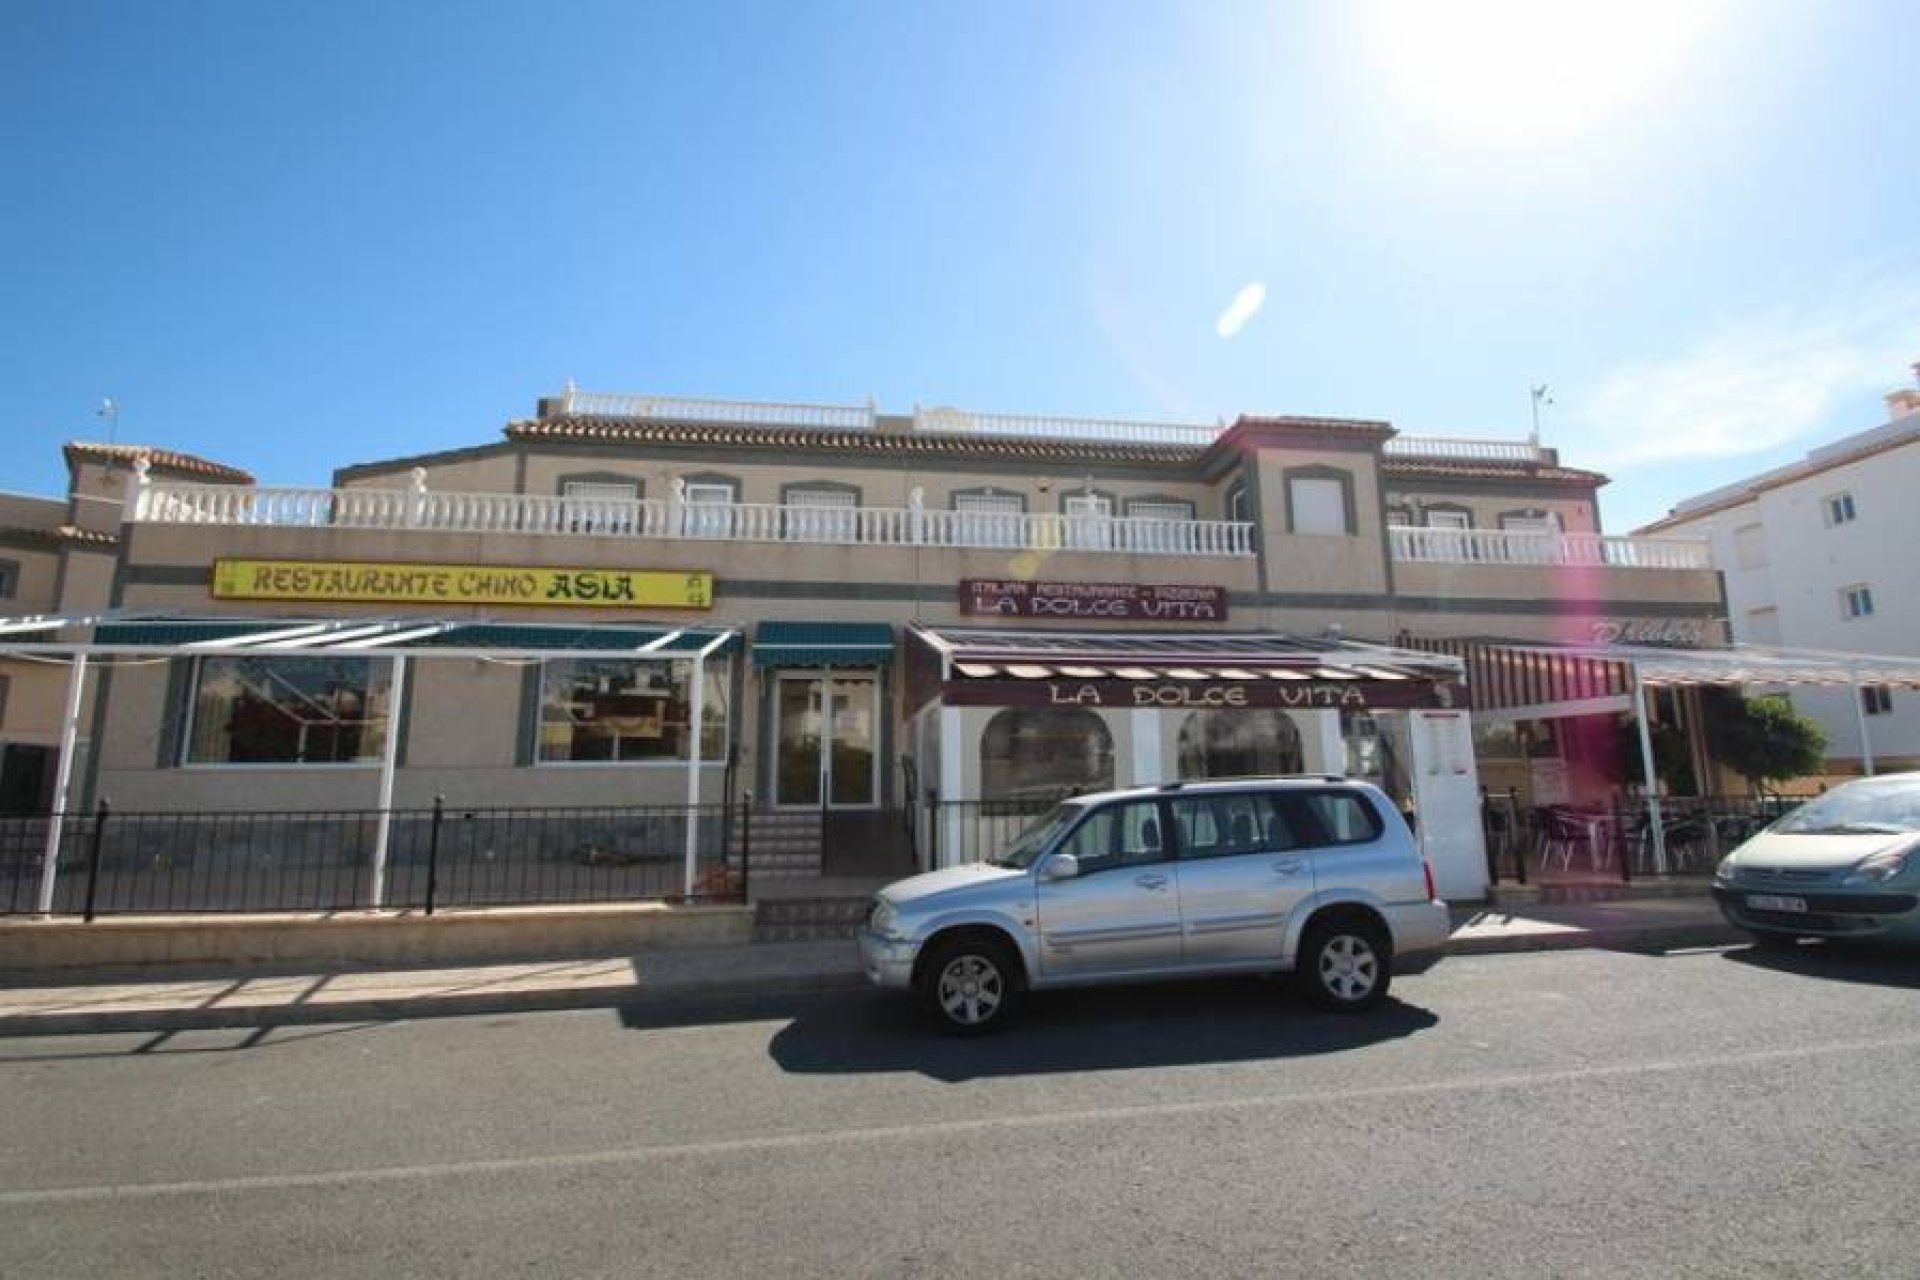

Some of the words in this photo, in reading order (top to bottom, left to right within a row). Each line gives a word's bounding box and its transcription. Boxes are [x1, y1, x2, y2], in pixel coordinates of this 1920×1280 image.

[253, 565, 450, 596] RESTAURANTE
[546, 572, 636, 601] ASIA
[975, 596, 1019, 615] LA
[1032, 596, 1129, 616] DOLCE
[1141, 599, 1216, 618] VITA
[1051, 684, 1101, 704] LA
[1132, 685, 1249, 706] DOLCE
[1280, 685, 1366, 706] VITA
